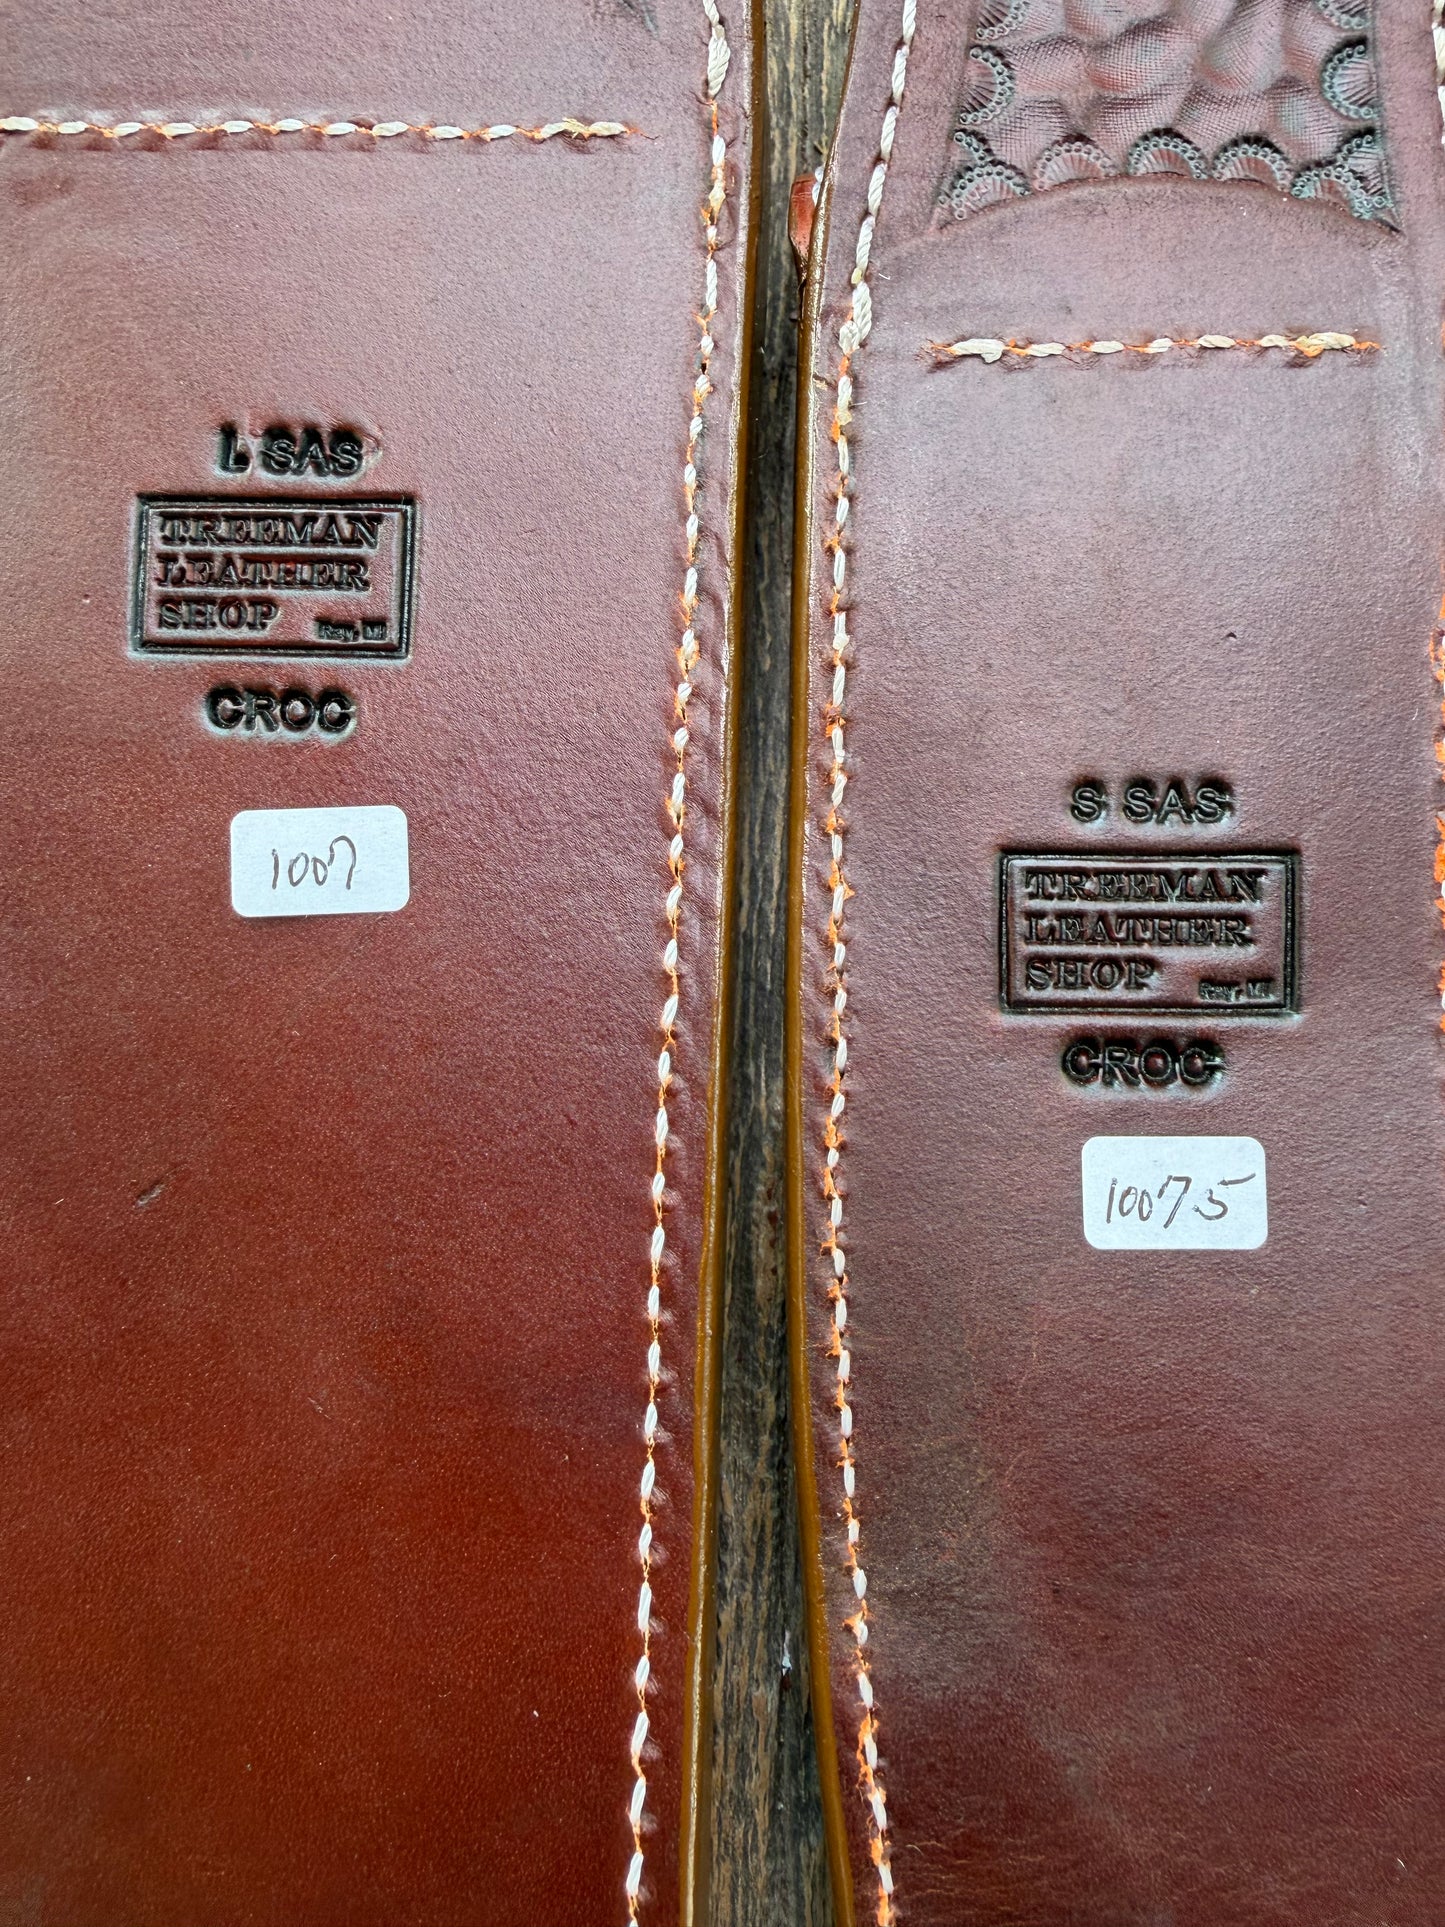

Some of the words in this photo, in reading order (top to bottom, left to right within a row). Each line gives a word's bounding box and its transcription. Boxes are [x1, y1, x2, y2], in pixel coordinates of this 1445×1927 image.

[216, 422, 251, 474] L
[260, 425, 364, 478] SAS
[159, 511, 383, 550] TREEMAN
[156, 553, 371, 592] LEATHER
[157, 598, 281, 631] SHOP
[205, 685, 355, 733] CROC
[1069, 778, 1107, 824] S
[1122, 777, 1233, 824] SAS
[271, 835, 357, 890] 1007
[1024, 867, 1266, 905] TREEMAN
[1023, 910, 1253, 948] LEATHER
[1025, 954, 1160, 991] SHOP
[1062, 1039, 1224, 1087] CROC
